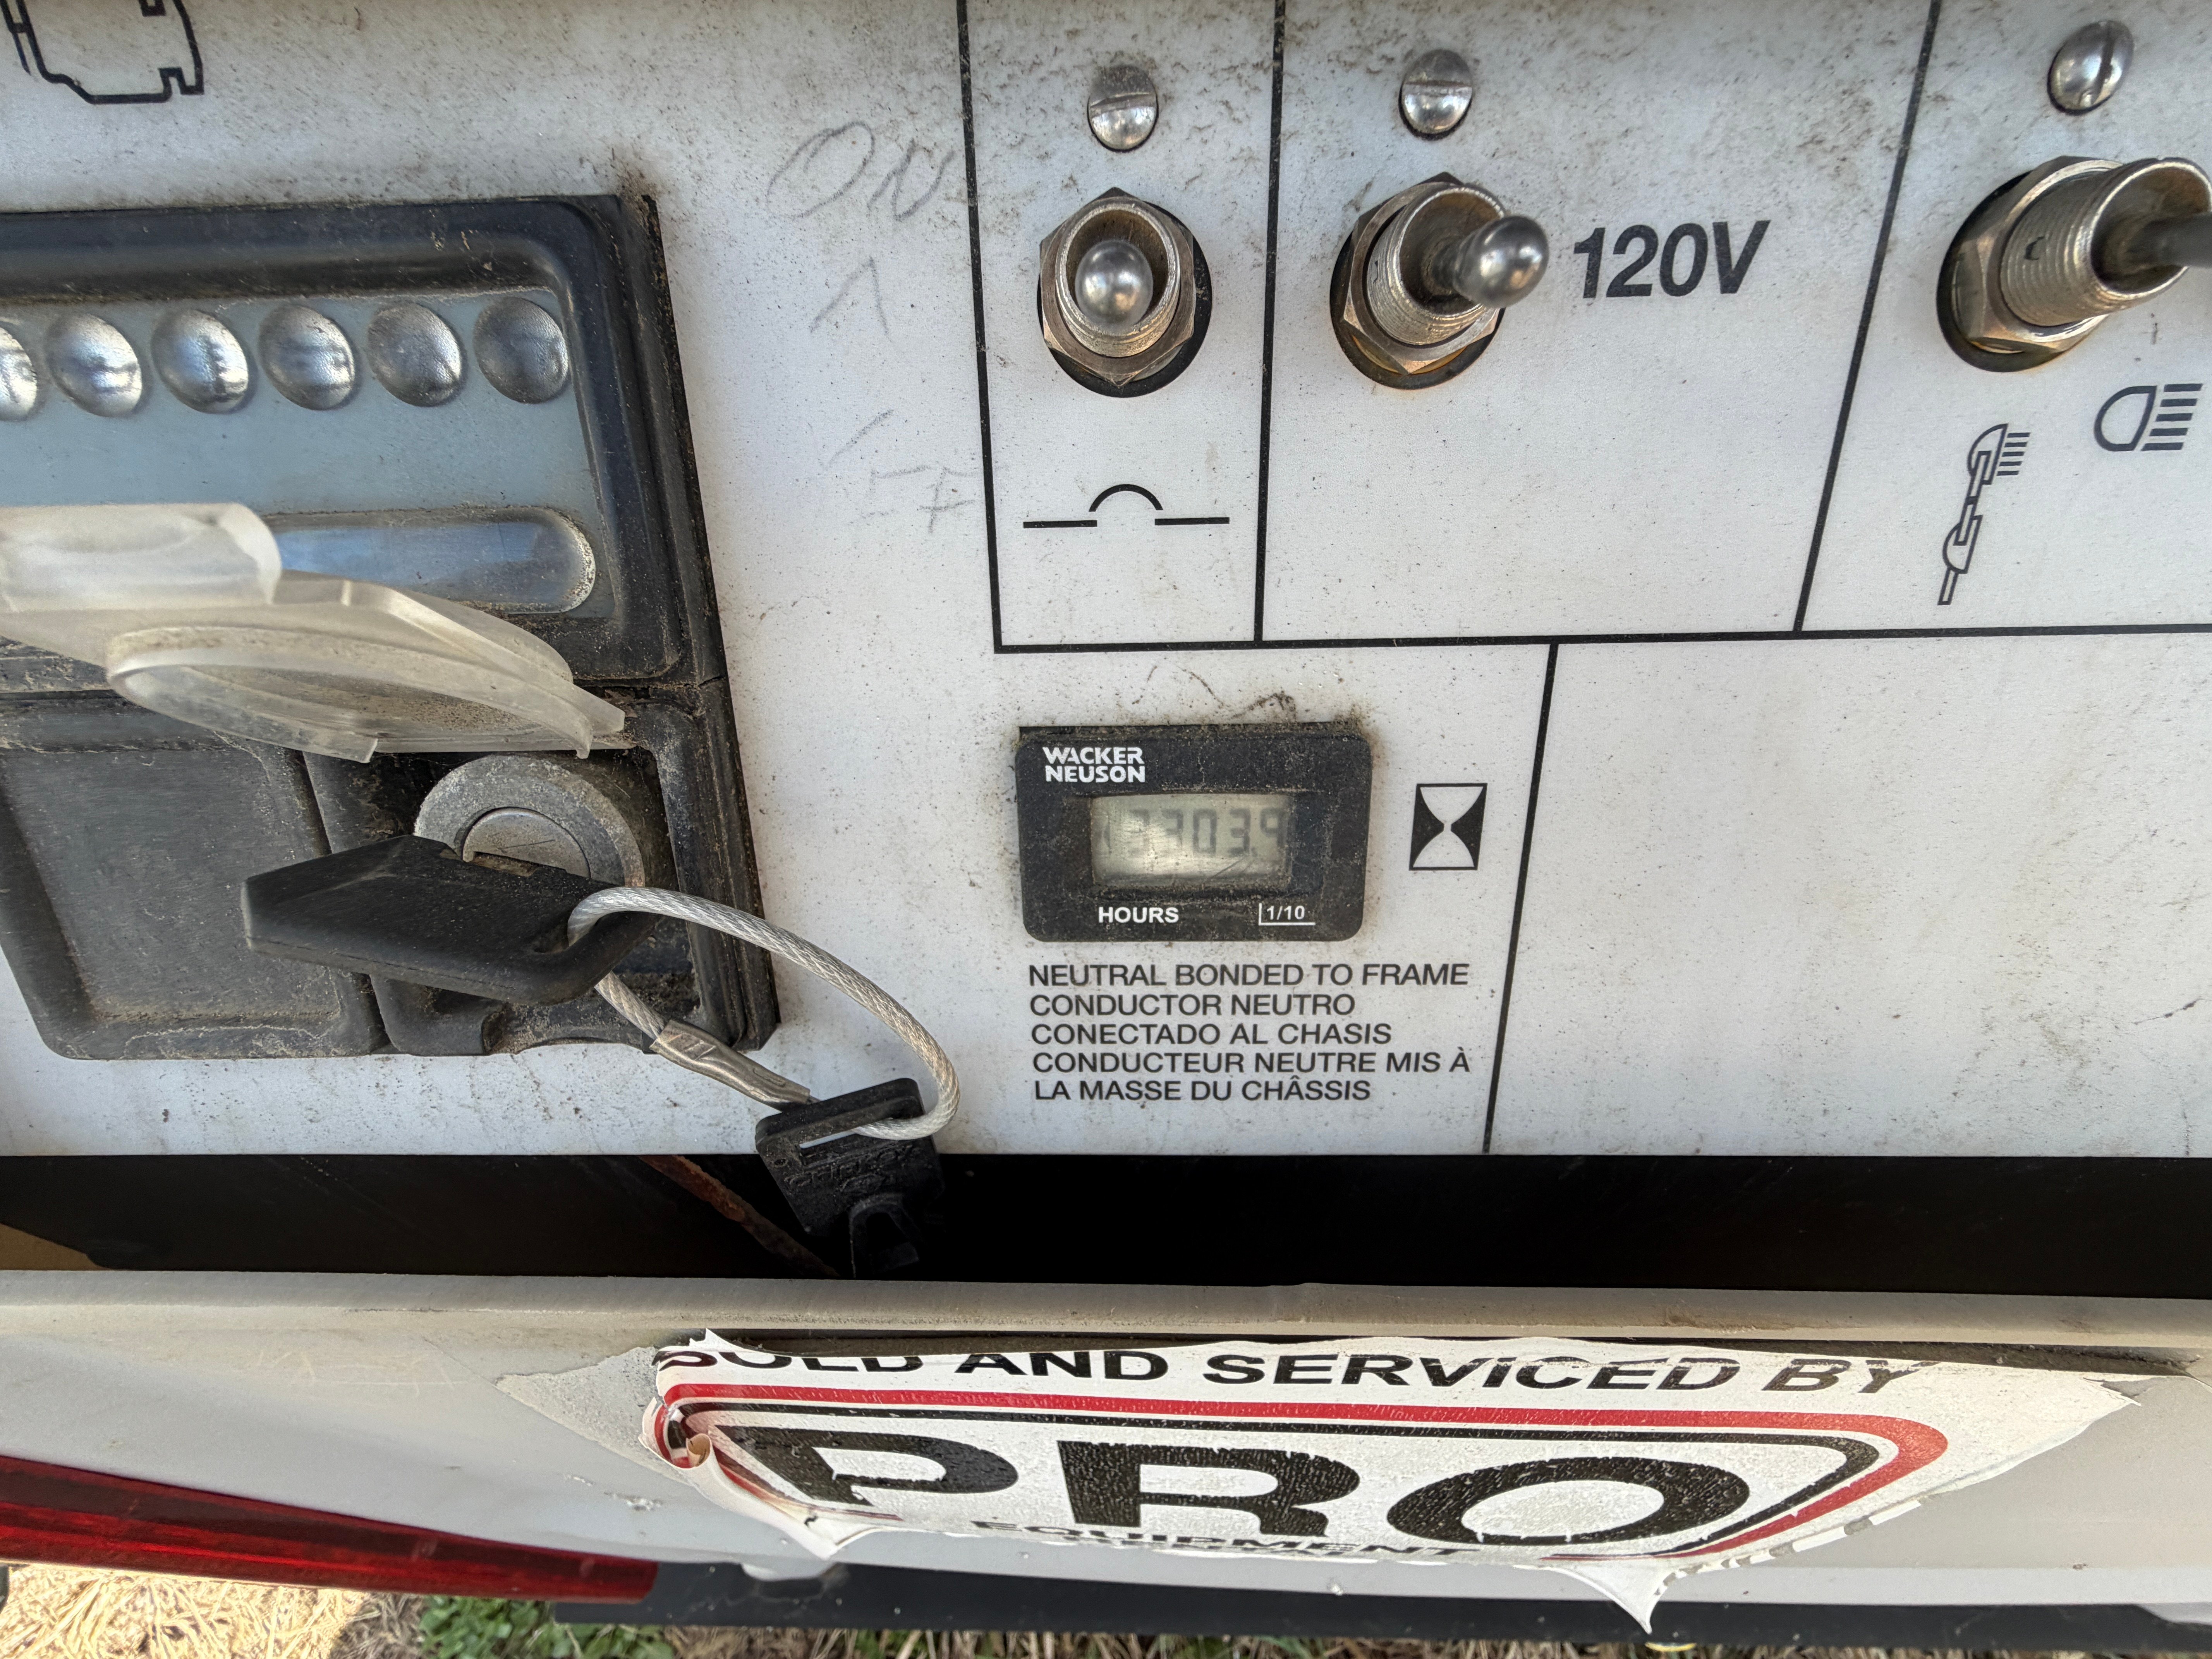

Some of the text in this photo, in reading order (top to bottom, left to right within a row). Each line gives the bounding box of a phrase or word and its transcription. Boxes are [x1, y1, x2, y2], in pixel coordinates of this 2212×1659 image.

[1573, 220, 1771, 299] 120V
[1042, 747, 1145, 764] WACKER
[1045, 765, 1145, 783] NEUSON
[1099, 906, 1179, 923] HOURS
[1266, 905, 1305, 920] 1/10
[1029, 963, 1470, 986] NEUTRAL BONDED TO FRAME
[1030, 994, 1355, 1016] CONDUCTOR NEUTRO
[1032, 1023, 1392, 1045] CONECTADO AL CHASIS
[1033, 1046, 1470, 1073] CONDUCTEUR NEUTRE MIS À
[1035, 1075, 1371, 1101] LA MASSE DU CHÂSSIS
[954, 1350, 1169, 1381] AND
[1202, 1353, 1741, 1390] SERVICED
[1760, 1358, 1941, 1394] BY
[714, 1424, 1750, 1546] PRO
